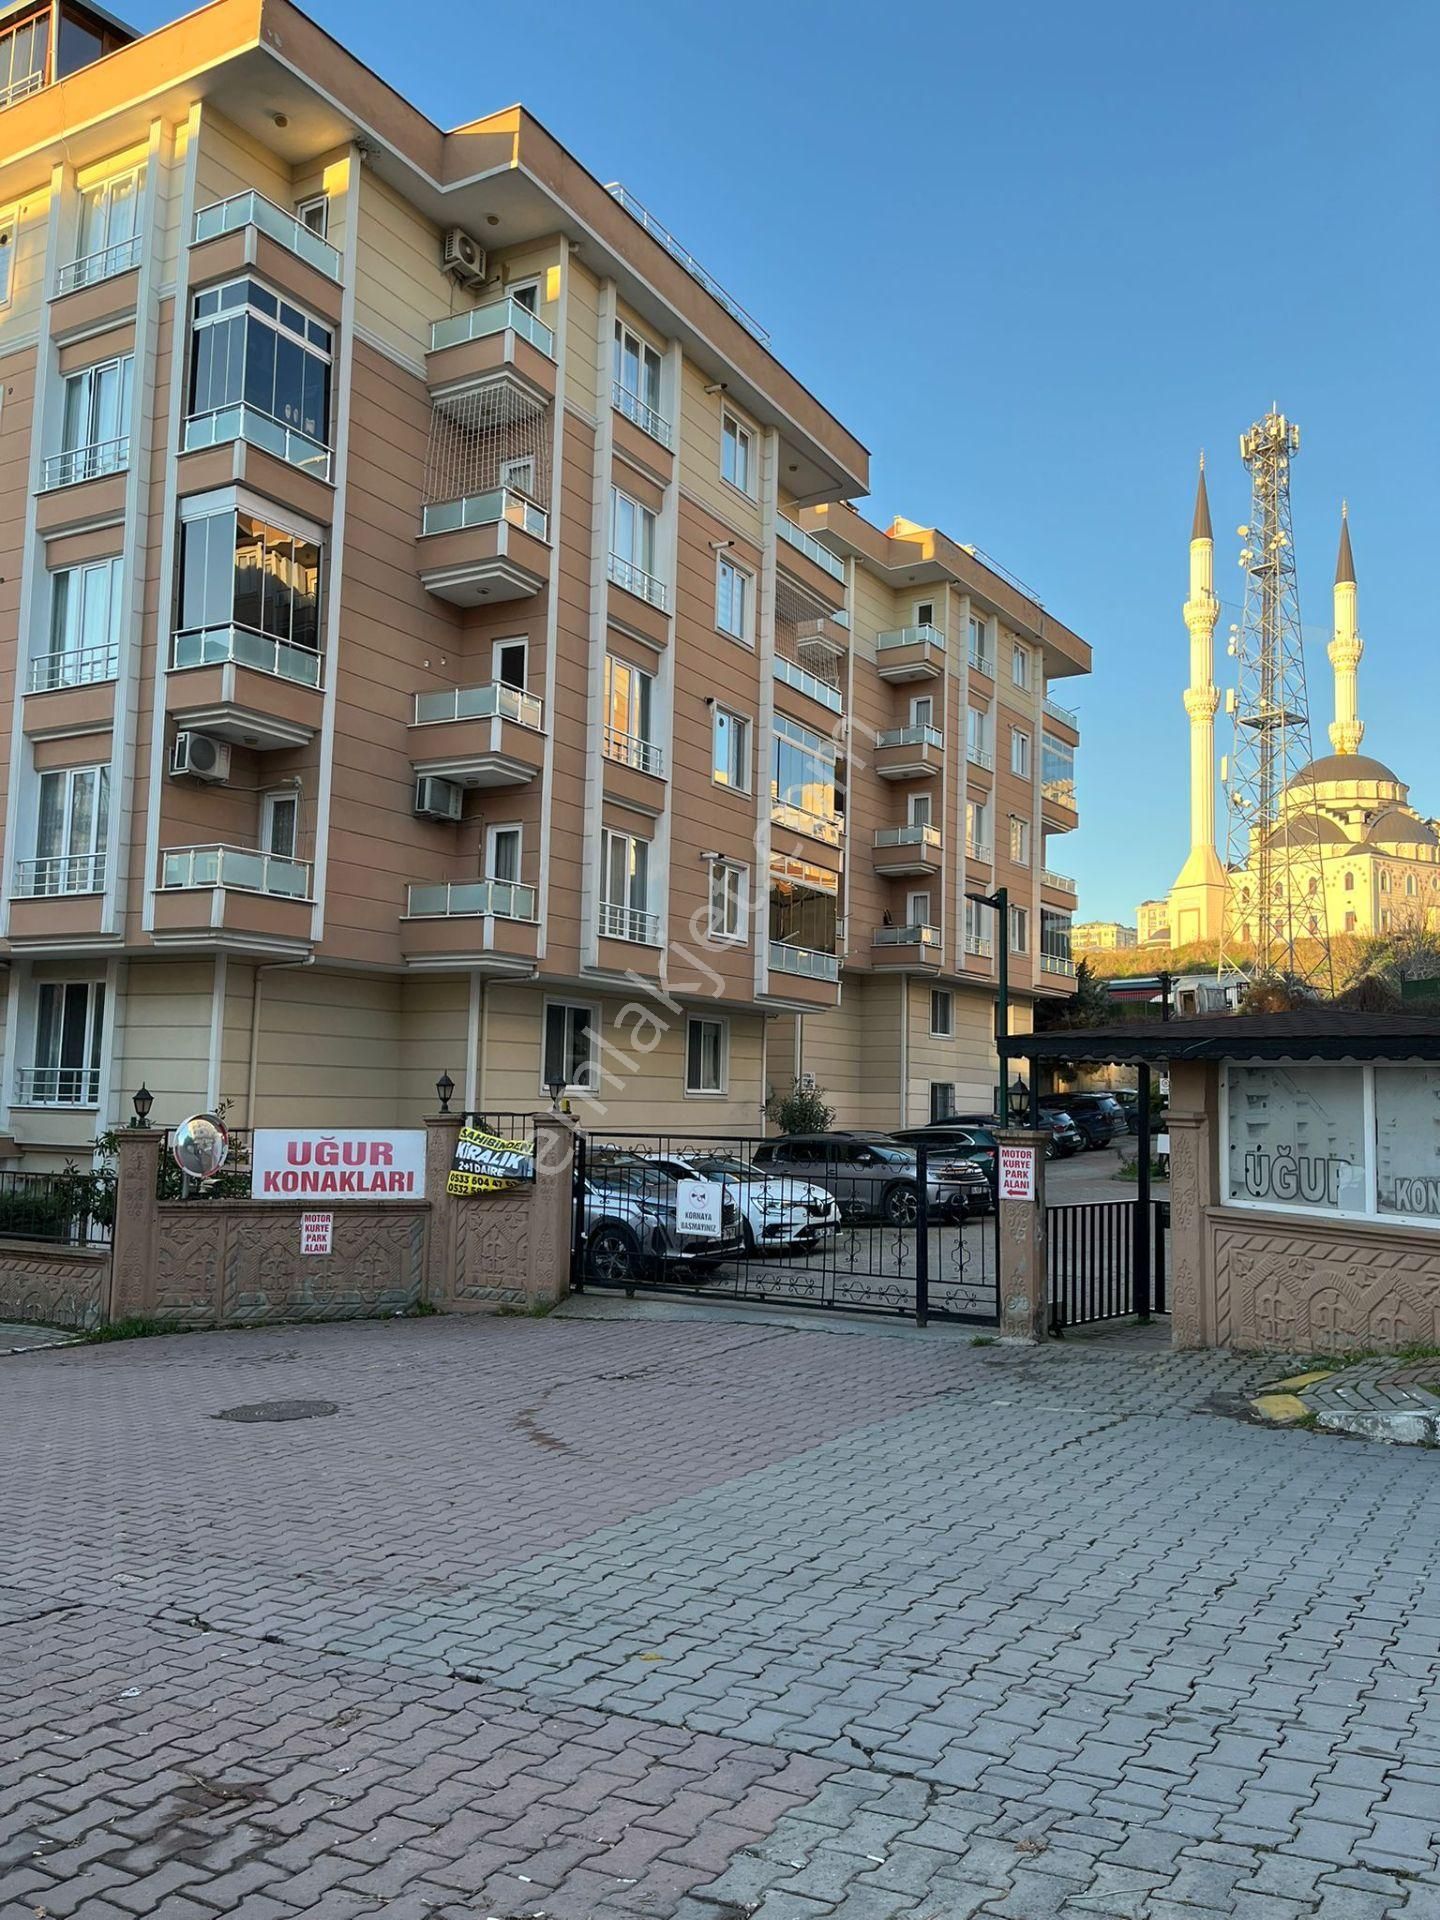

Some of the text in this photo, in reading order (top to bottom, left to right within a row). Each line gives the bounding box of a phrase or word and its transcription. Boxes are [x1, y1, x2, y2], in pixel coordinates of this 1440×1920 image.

[287, 1136, 394, 1166] UĞUR
[455, 1141, 526, 1169] KİRALIK
[1001, 1149, 1032, 1159] MOTOR
[458, 1161, 473, 1172] 2+1
[1003, 1159, 1031, 1169] KURYE
[1005, 1169, 1029, 1179] PARK
[263, 1170, 414, 1192] KONAKLARI
[449, 1173, 469, 1184] 0533
[471, 1176, 490, 1187] 604
[1003, 1180, 1030, 1189] ALANI
[448, 1183, 469, 1194] 0532
[304, 1214, 331, 1223] MOTOR
[685, 1211, 712, 1221] KORNAYA
[304, 1224, 330, 1232] KURYE
[306, 1234, 327, 1242] PARK
[304, 1243, 327, 1252] ALANI
